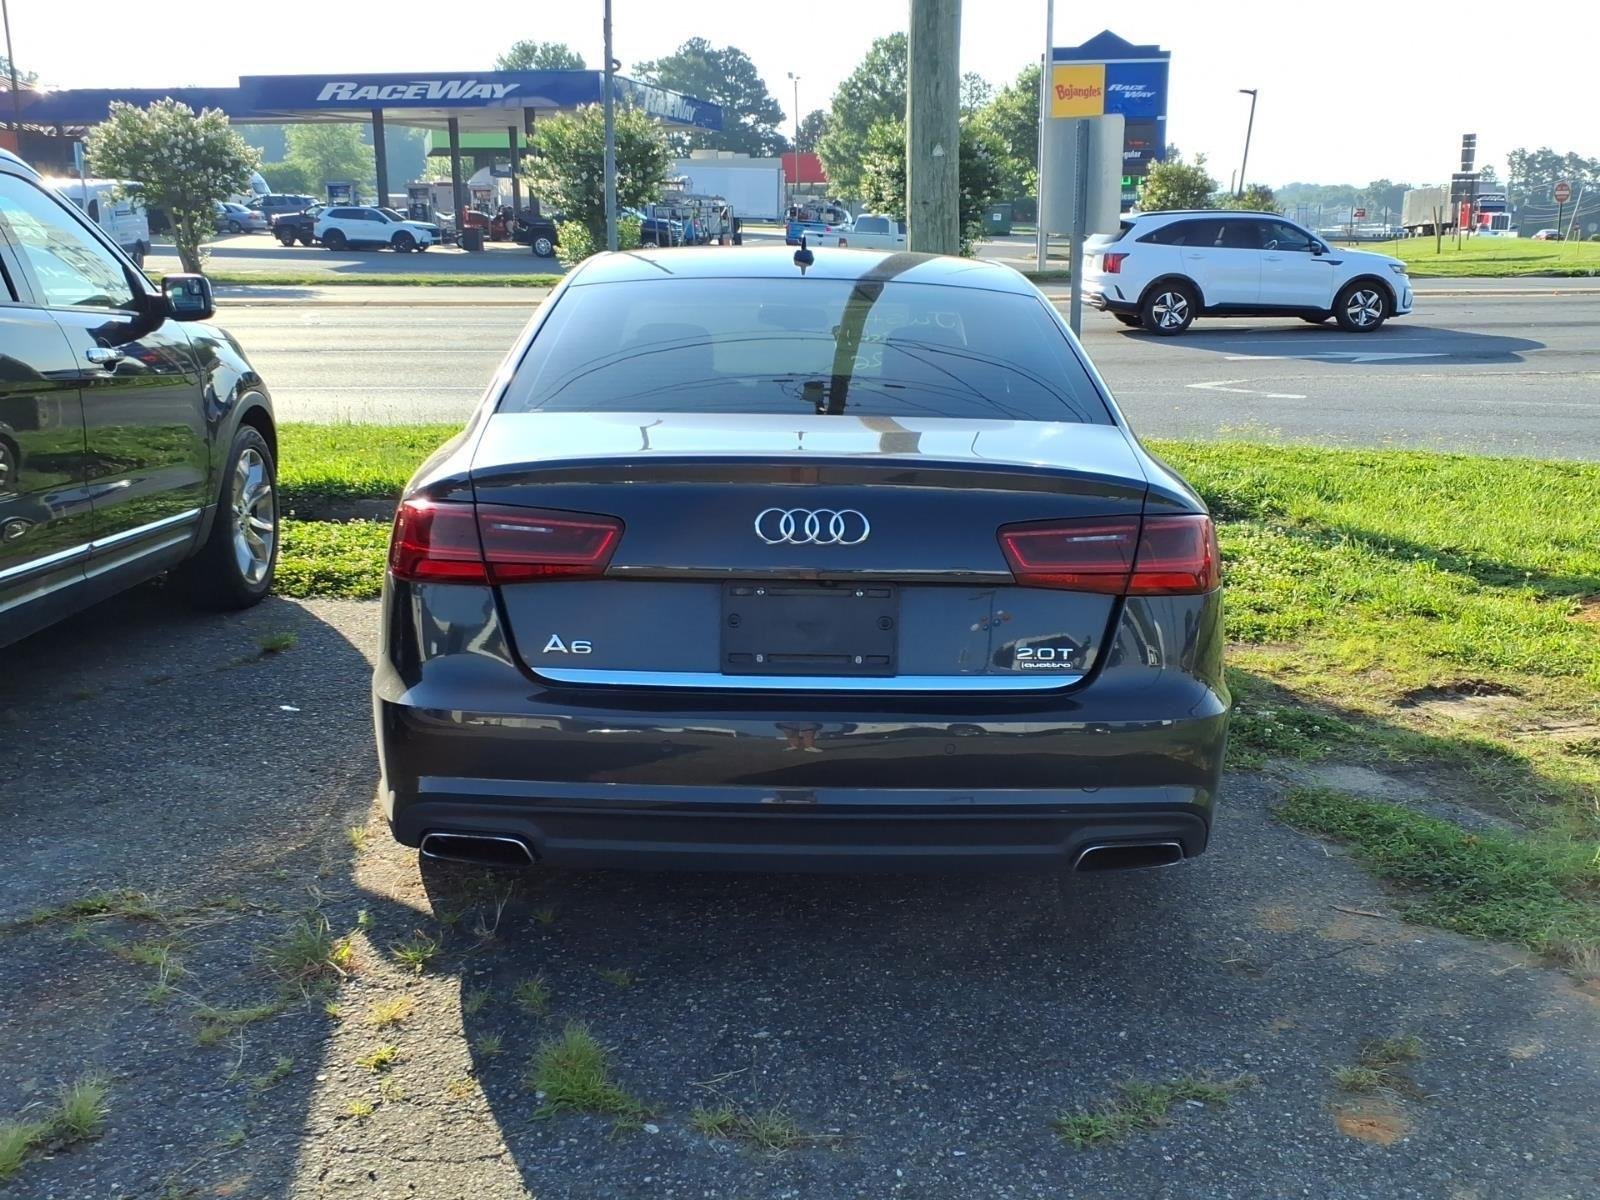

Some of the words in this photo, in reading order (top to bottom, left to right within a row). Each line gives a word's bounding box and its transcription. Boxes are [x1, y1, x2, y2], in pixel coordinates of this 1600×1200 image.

[1054, 84, 1101, 100] Bojangles
[1123, 149, 1141, 160] gular
[543, 634, 592, 654] A6
[1017, 648, 1073, 660] 2.0T
[1022, 661, 1072, 669] quattro
